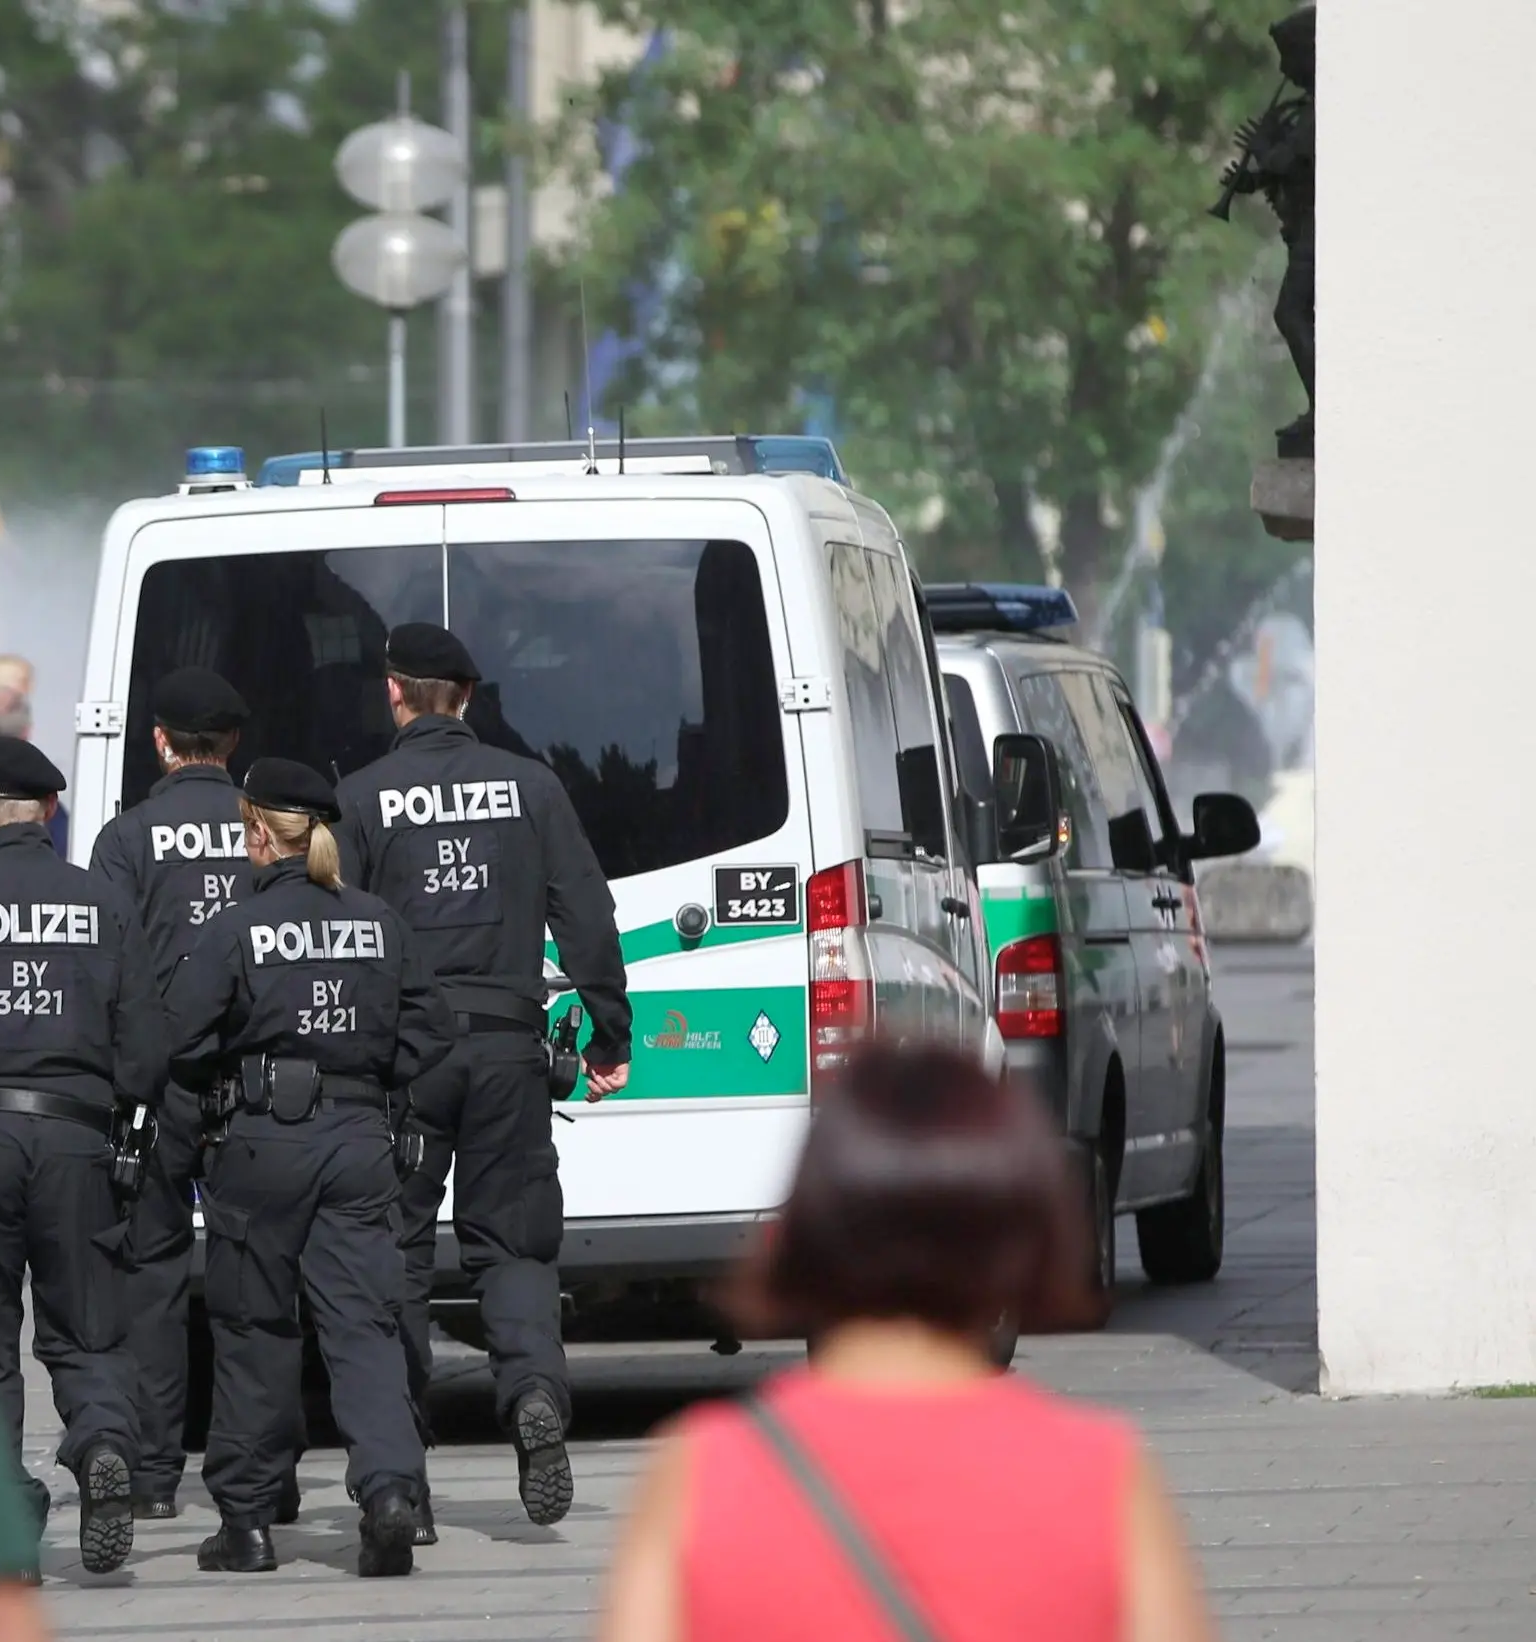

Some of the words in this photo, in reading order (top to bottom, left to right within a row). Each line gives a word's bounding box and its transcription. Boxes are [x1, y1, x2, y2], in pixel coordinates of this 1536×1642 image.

[379, 779, 522, 828] POLIZEI
[151, 822, 248, 862] POLIZ
[437, 837, 471, 865] BY
[203, 874, 237, 899] BY
[423, 864, 489, 894] 3421
[739, 871, 773, 891] BY
[727, 898, 786, 919] 3423
[249, 919, 385, 965] POLIZEI
[12, 960, 49, 988] BY
[312, 979, 344, 1007] BY
[297, 1006, 357, 1036] 3421
[686, 1031, 721, 1041] HILFT
